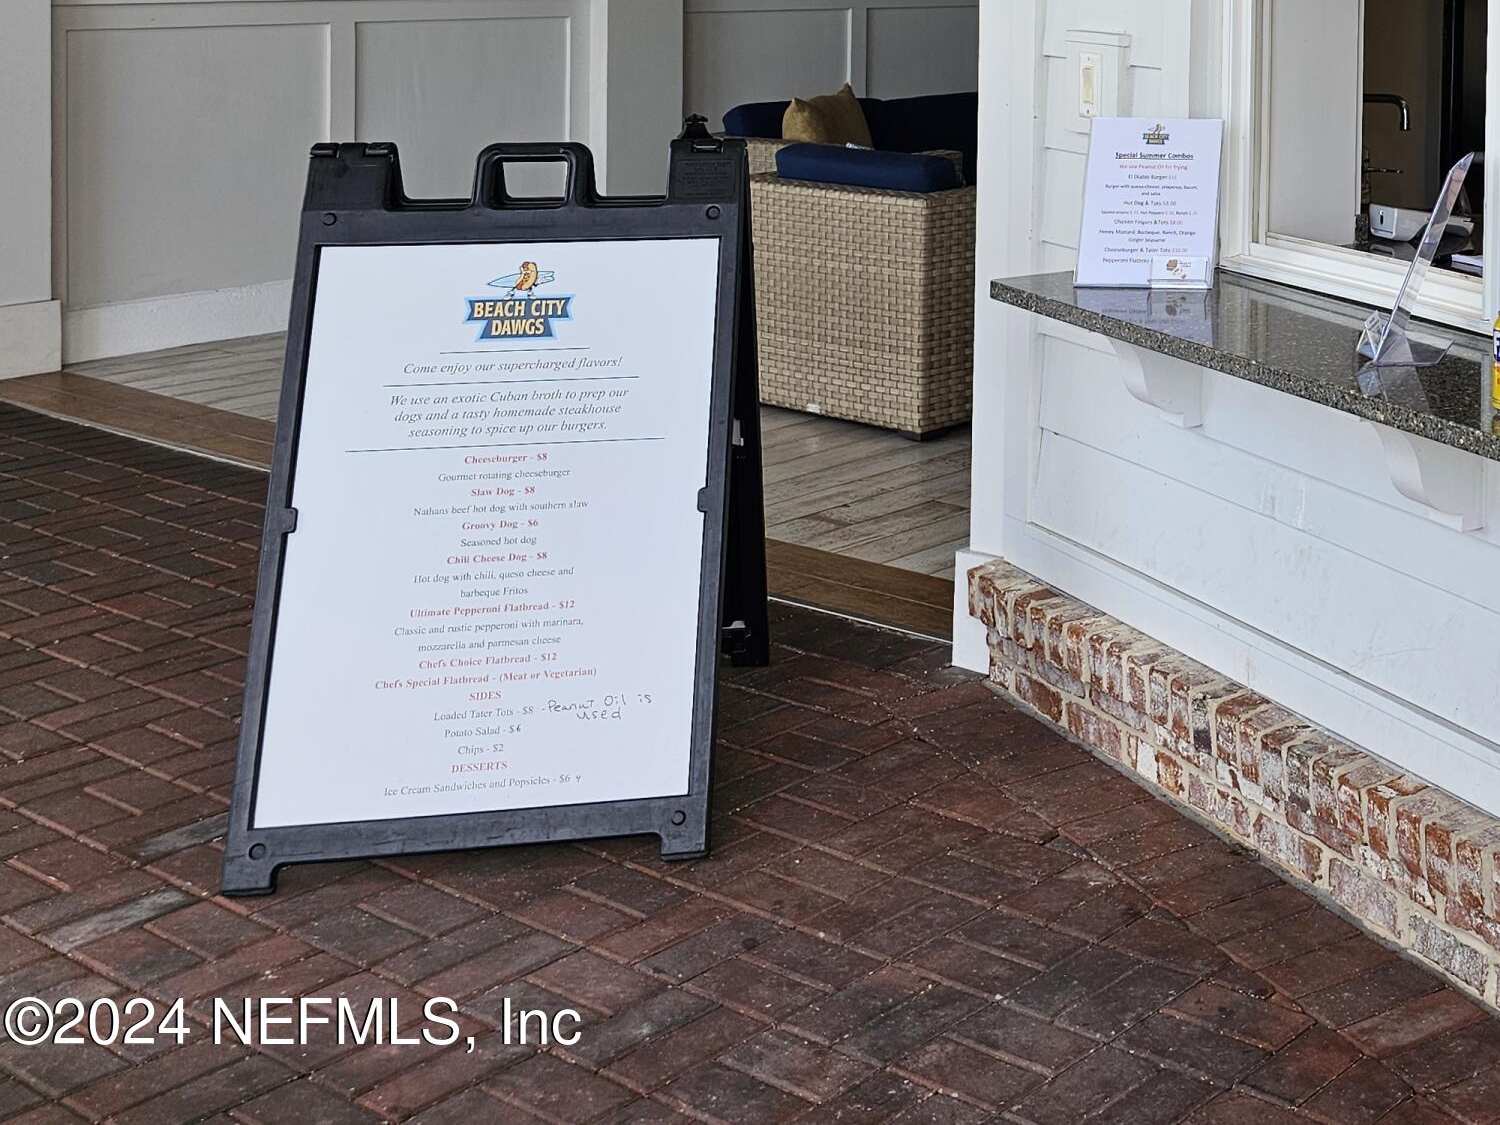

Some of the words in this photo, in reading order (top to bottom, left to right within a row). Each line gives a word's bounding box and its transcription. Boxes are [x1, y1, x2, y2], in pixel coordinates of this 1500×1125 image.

[473, 300, 526, 318] BEACH
[530, 299, 566, 317] CITY
[490, 318, 545, 337] DAWGS
[403, 361, 438, 375] Come
[440, 361, 473, 377] enjoy
[475, 362, 496, 372] our
[497, 356, 576, 375] supercharged
[575, 355, 624, 371] flavors!
[389, 394, 412, 407] We
[413, 396, 432, 406] use
[433, 396, 449, 405] an
[451, 392, 488, 405] exotic
[489, 390, 529, 403] Cuban
[530, 388, 563, 402] broth
[564, 389, 578, 401] to
[579, 388, 607, 403] prep
[608, 387, 630, 398] our
[394, 410, 423, 425] dogs
[425, 407, 450, 422] and
[461, 408, 490, 423] tasty
[492, 404, 556, 419] homemade
[558, 401, 622, 416] steakhouse
[407, 424, 468, 439] seasoning
[470, 425, 483, 435] to
[484, 422, 517, 437] spice
[518, 424, 535, 436] up
[537, 423, 557, 432] our
[559, 418, 607, 434] burgers.
[464, 453, 528, 465] Cheeseburger
[536, 452, 548, 462] $8
[438, 471, 478, 482] Gourmet
[514, 468, 571, 479] cheeseburger
[471, 487, 493, 497] Slaw
[496, 487, 515, 498] Dog
[524, 485, 536, 495] $8
[413, 506, 449, 516] Nathans
[450, 505, 472, 514] beef
[472, 504, 488, 514] hot
[489, 503, 506, 514] dog
[508, 502, 528, 512] with
[530, 500, 567, 511] southern
[568, 499, 589, 509] slaw
[461, 520, 497, 532] Groovy
[499, 519, 519, 530] Dog
[527, 518, 539, 528] $6
[460, 537, 502, 548] Seasoned
[503, 536, 519, 546] hot
[520, 535, 537, 546] dog
[446, 554, 470, 565] Chili
[472, 553, 506, 564] Cheese
[508, 552, 528, 563] Dog
[536, 551, 548, 561] $8
[413, 574, 431, 584] Hot
[432, 573, 450, 584] dog
[452, 571, 473, 582] with
[498, 570, 525, 580] queso
[526, 568, 556, 578] cheese
[557, 566, 575, 576] and
[460, 587, 501, 599] barbeque
[502, 586, 529, 596] Fritos
[409, 607, 451, 619] Ultimate
[453, 605, 501, 617] Pepperoni
[503, 602, 549, 613] Flatbread
[558, 600, 576, 610] $12
[394, 626, 427, 637] Classic
[428, 624, 446, 635] and
[447, 623, 473, 634] rustic
[474, 621, 519, 634] pepperoni
[521, 620, 541, 630] with
[417, 642, 467, 653] mozzarella
[468, 640, 485, 650] and
[487, 638, 530, 650] parmesan
[531, 635, 562, 646] cheese
[449, 656, 483, 668] Choice
[484, 654, 531, 666] Flatbread
[540, 652, 558, 662] $12
[405, 676, 441, 689] Special
[443, 673, 490, 686] Flatbread
[499, 671, 528, 684] (Meat
[530, 672, 542, 681] or
[543, 666, 598, 680] Vegetarian)
[469, 690, 503, 702] SIDES
[603, 693, 627, 707] Oil
[636, 693, 653, 705] is
[433, 710, 468, 722] Loaded
[470, 708, 494, 720] Tater
[495, 707, 515, 718] Tots
[522, 705, 535, 716] $8
[575, 708, 623, 721] used
[444, 727, 473, 738] Potato
[475, 725, 501, 737] Salad
[457, 744, 485, 756] Chips
[492, 743, 505, 754] $2
[451, 760, 509, 773] DESSERTS
[384, 787, 399, 797] Ice
[400, 785, 432, 797] Cream
[433, 781, 488, 794] Sandwiches
[489, 779, 507, 790] and
[508, 776, 551, 789] Popsicles
